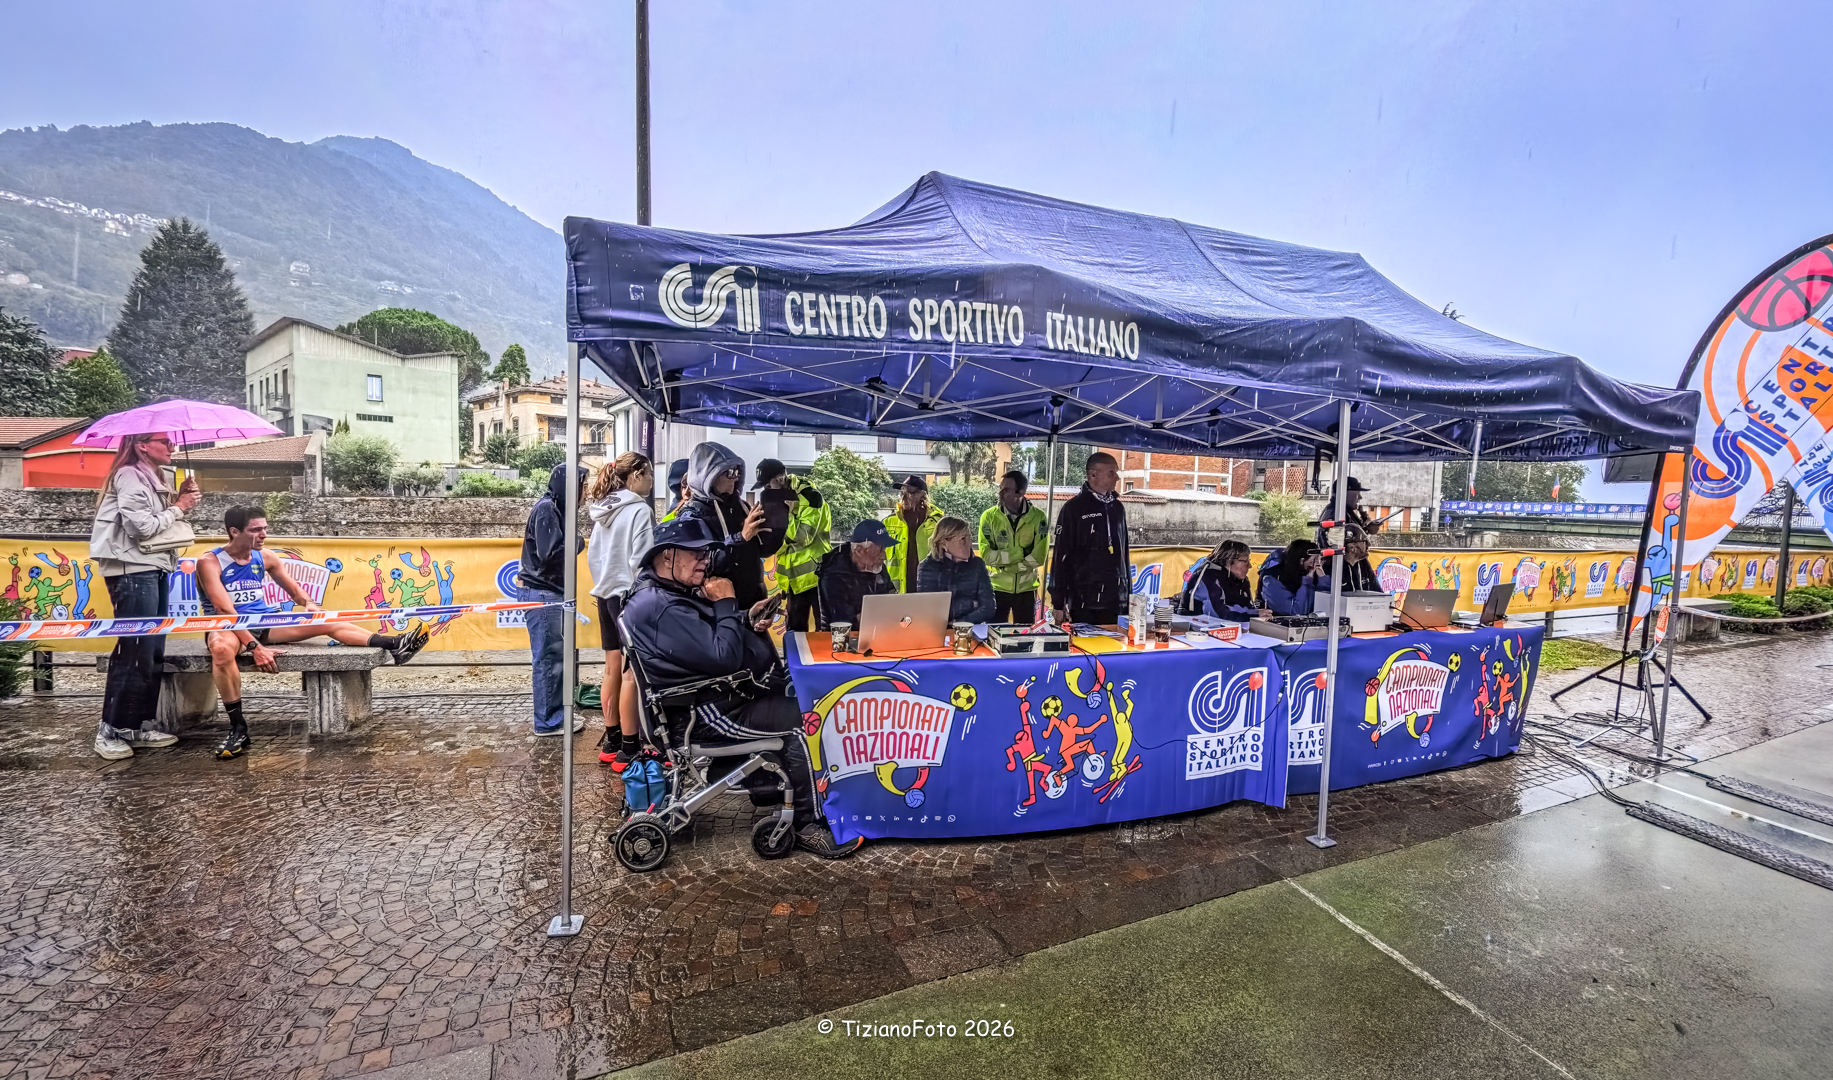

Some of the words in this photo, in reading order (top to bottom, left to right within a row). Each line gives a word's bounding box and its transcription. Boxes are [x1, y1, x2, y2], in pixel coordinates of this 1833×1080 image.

[785, 291, 887, 340] CENTRO
[908, 298, 1025, 347] SPORTIVO
[1046, 310, 1140, 361] ITALIANO
[234, 591, 256, 602] 235
[1386, 665, 1447, 694] CAMPIONATI
[1388, 688, 1440, 721] NAZIONALI
[833, 697, 949, 734] CAMPIONATI
[1190, 733, 1261, 750] CENTRO
[1298, 728, 1324, 740] TRO
[842, 731, 940, 766] NAZIONALI
[1189, 743, 1261, 761] SPORTIVO
[1291, 749, 1324, 759] IANO
[1189, 753, 1260, 772] ITALIANO
